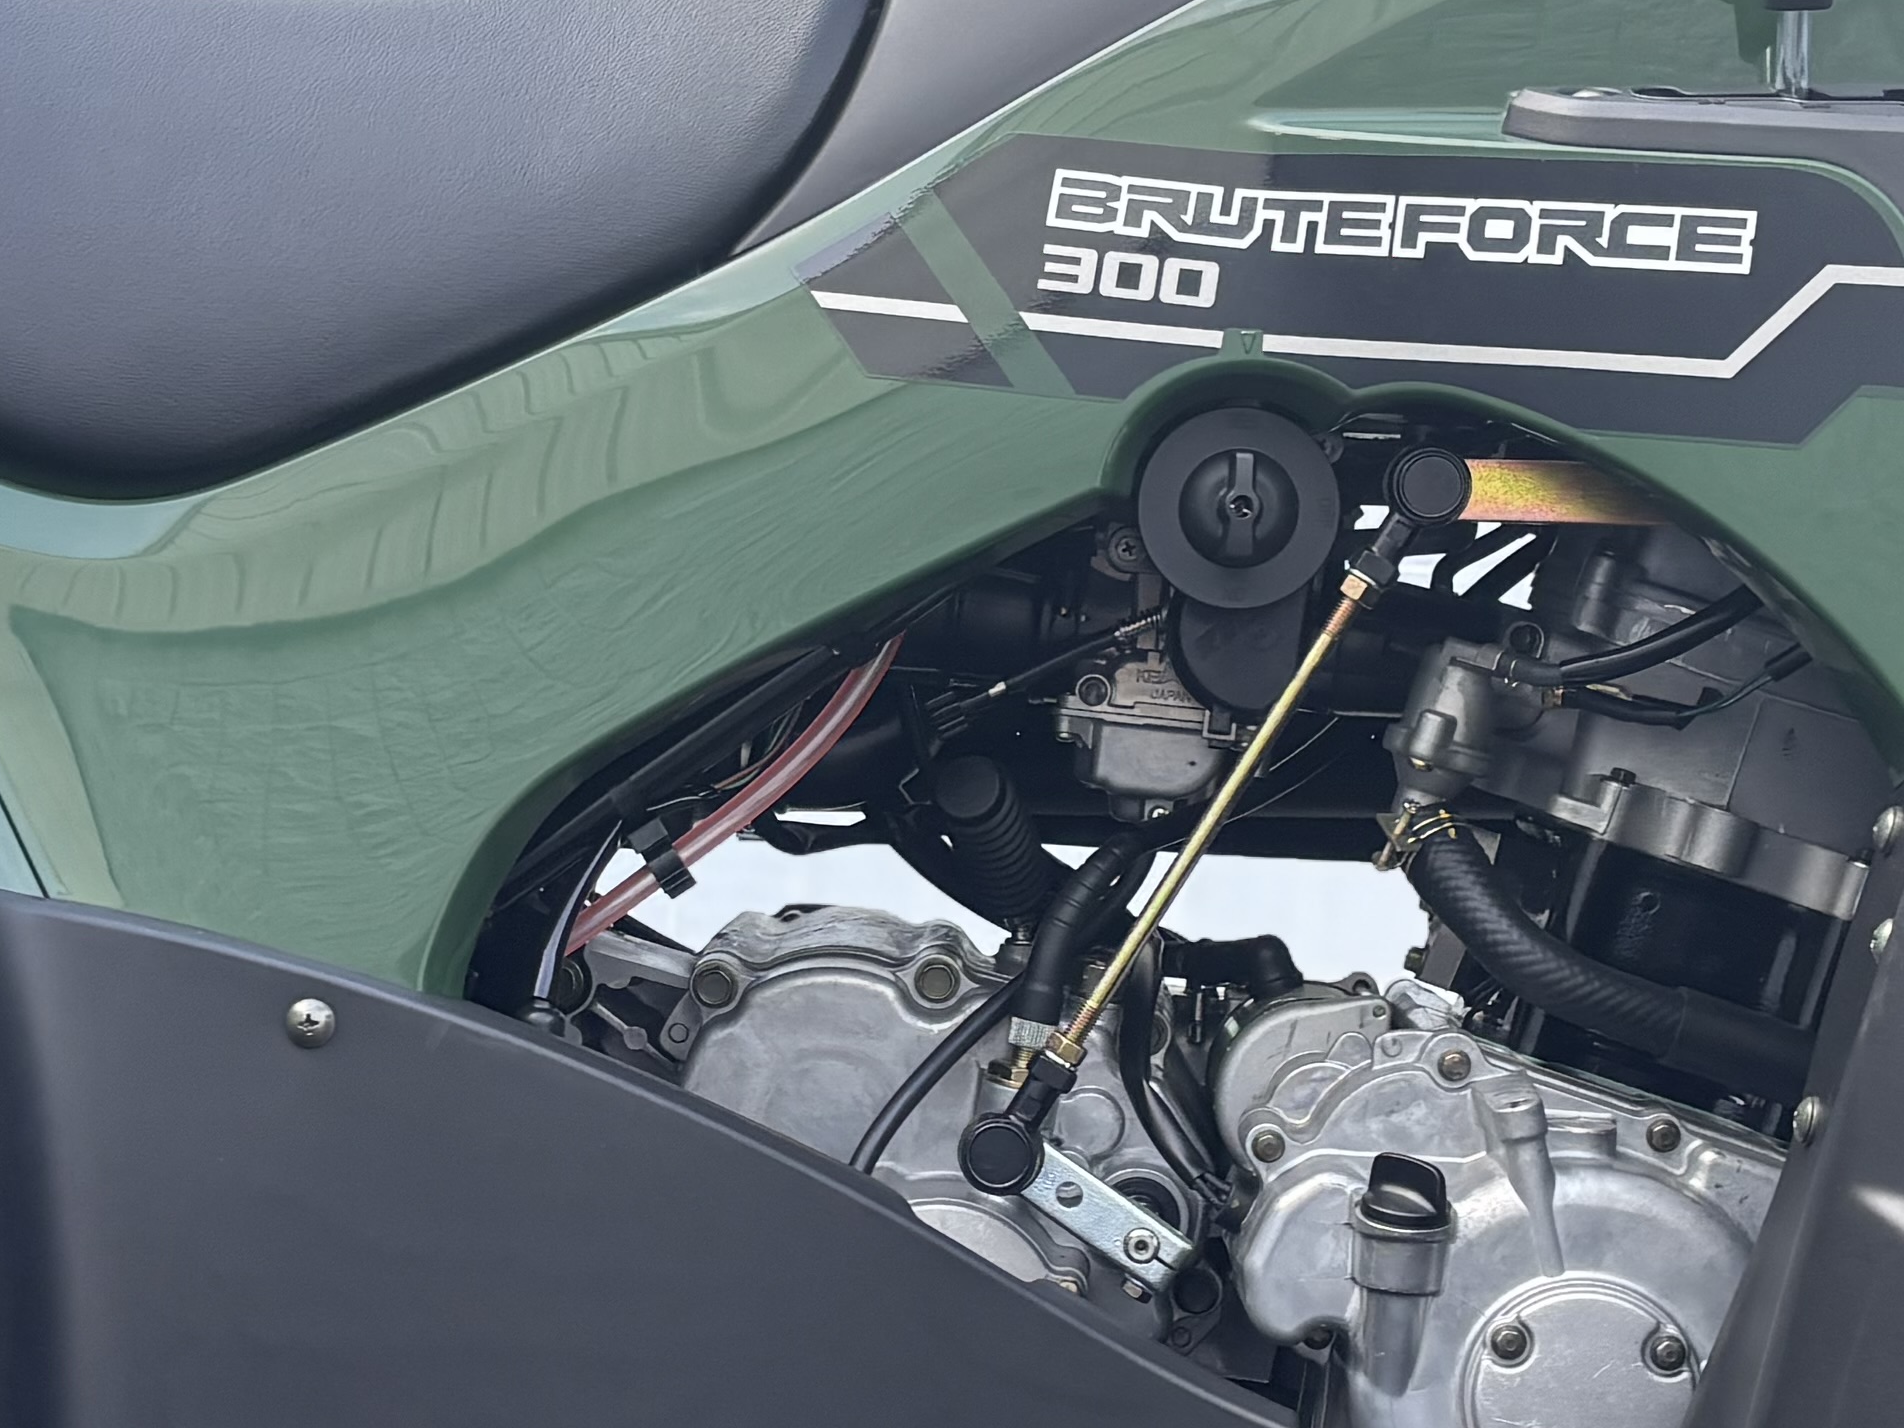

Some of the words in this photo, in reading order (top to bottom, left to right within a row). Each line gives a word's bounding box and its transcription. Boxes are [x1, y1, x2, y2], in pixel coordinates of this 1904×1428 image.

[1045, 168, 1397, 256] BRUTE
[1391, 194, 1758, 275] FORCE
[1037, 243, 1220, 309] 300
